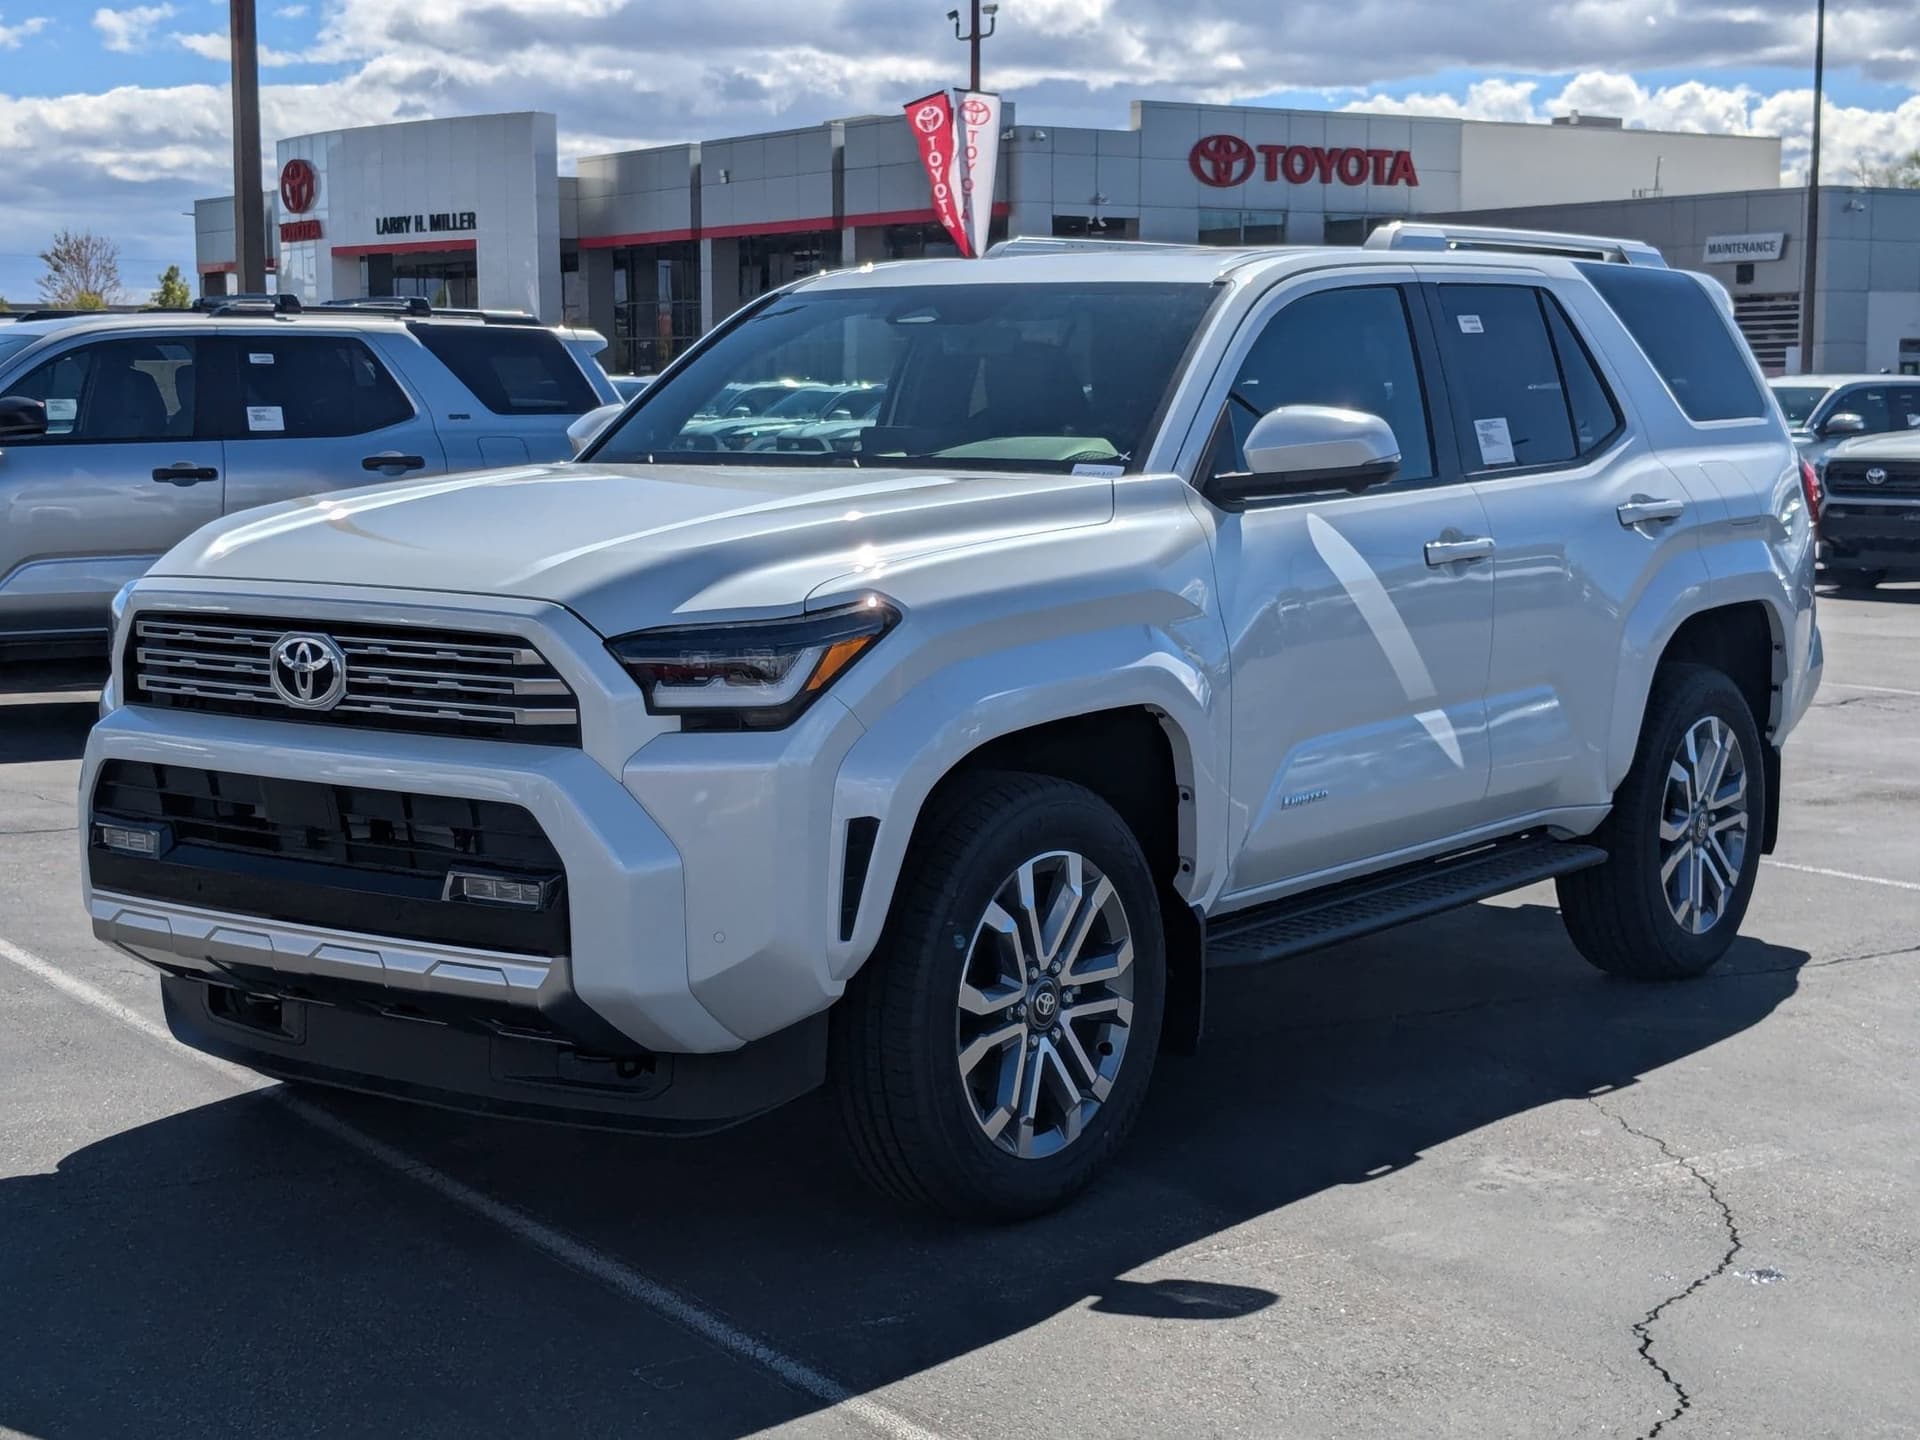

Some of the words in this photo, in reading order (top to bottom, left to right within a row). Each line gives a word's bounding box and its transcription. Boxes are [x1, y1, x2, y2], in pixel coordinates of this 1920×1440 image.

[927, 135, 956, 229] TOYOTA
[1257, 144, 1419, 187] TOYOTA
[376, 215, 411, 235] LARRY
[414, 214, 427, 233] H.
[429, 211, 477, 232] MILLER
[1707, 241, 1777, 255] MAINTENANCE
